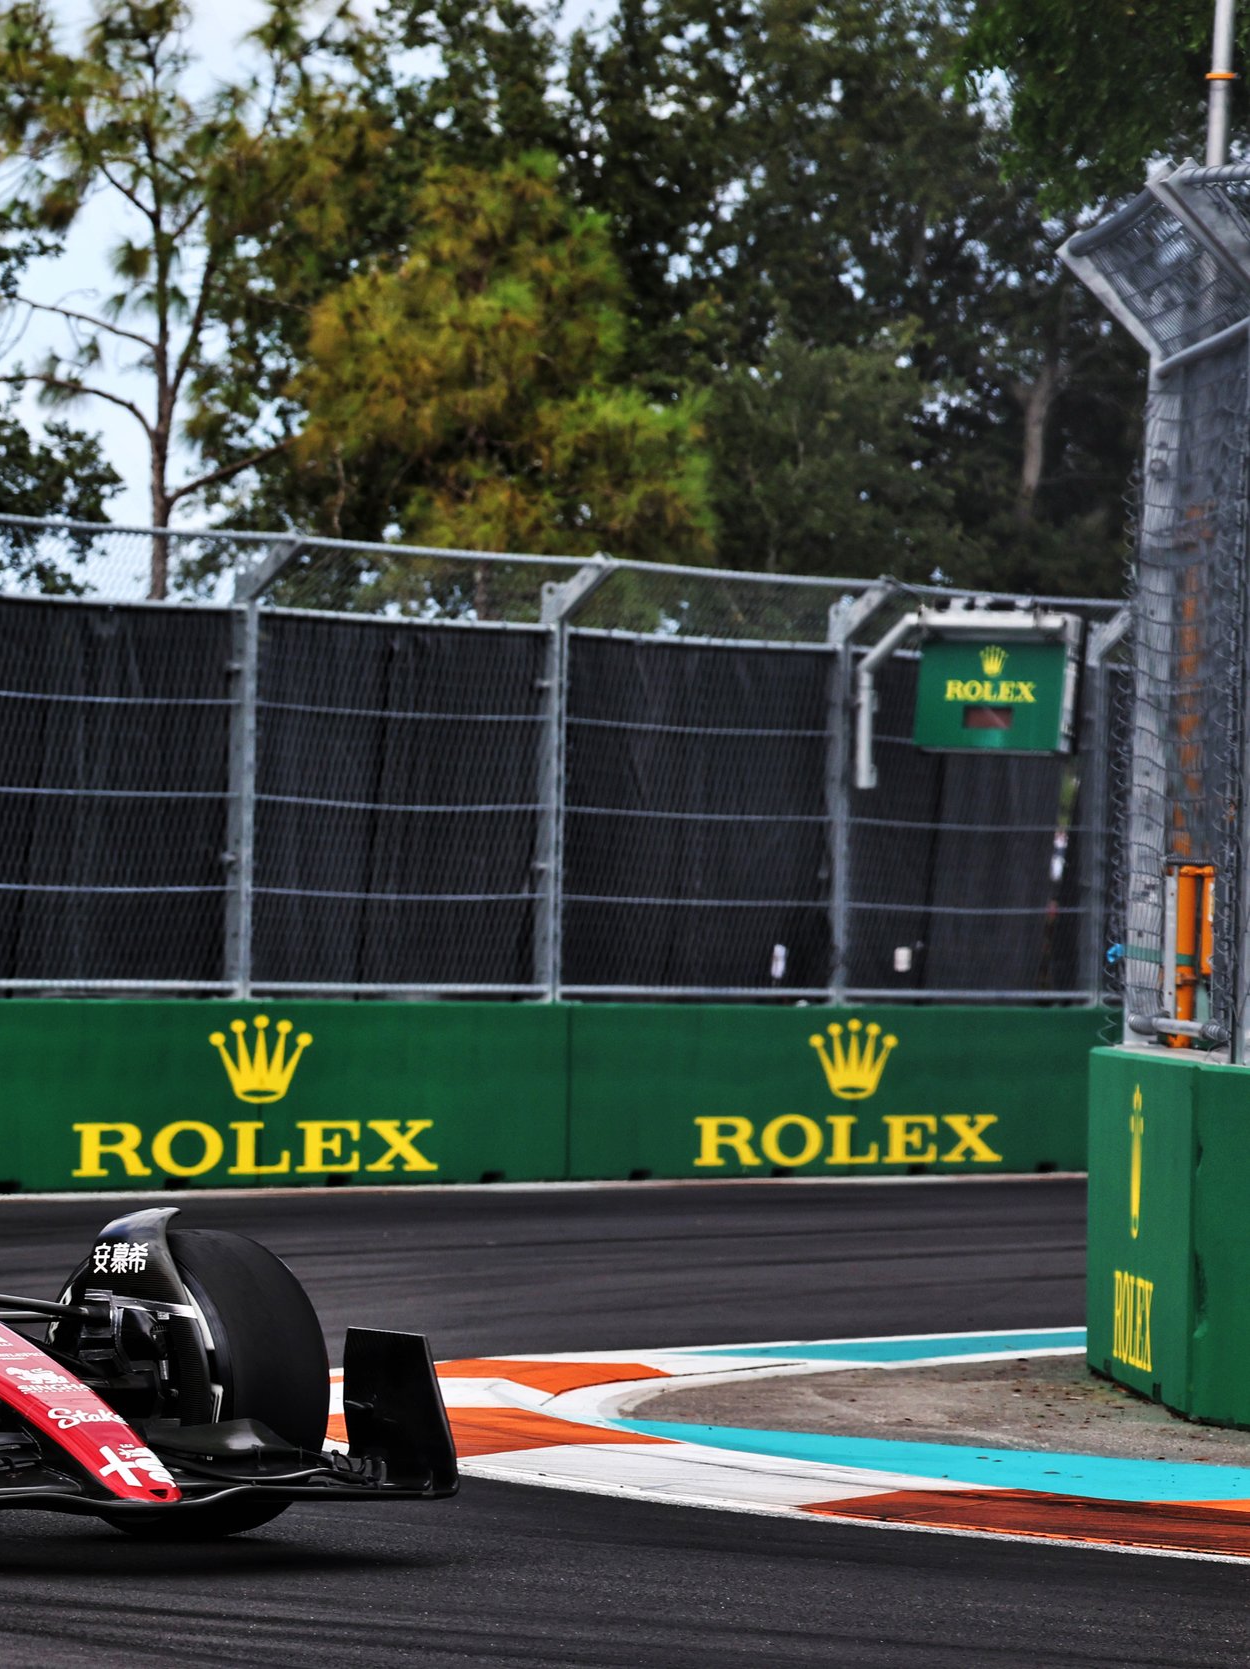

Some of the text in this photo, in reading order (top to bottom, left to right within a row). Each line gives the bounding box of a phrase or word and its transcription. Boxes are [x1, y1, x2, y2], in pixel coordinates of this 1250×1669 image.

[945, 679, 1037, 703] ROLEX
[72, 1119, 439, 1177] ROLEX
[693, 1113, 1003, 1167] ROLEX
[93, 1242, 149, 1274] 安慕希
[17, 1383, 93, 1394] SINGHA
[47, 1407, 130, 1430] Stake
